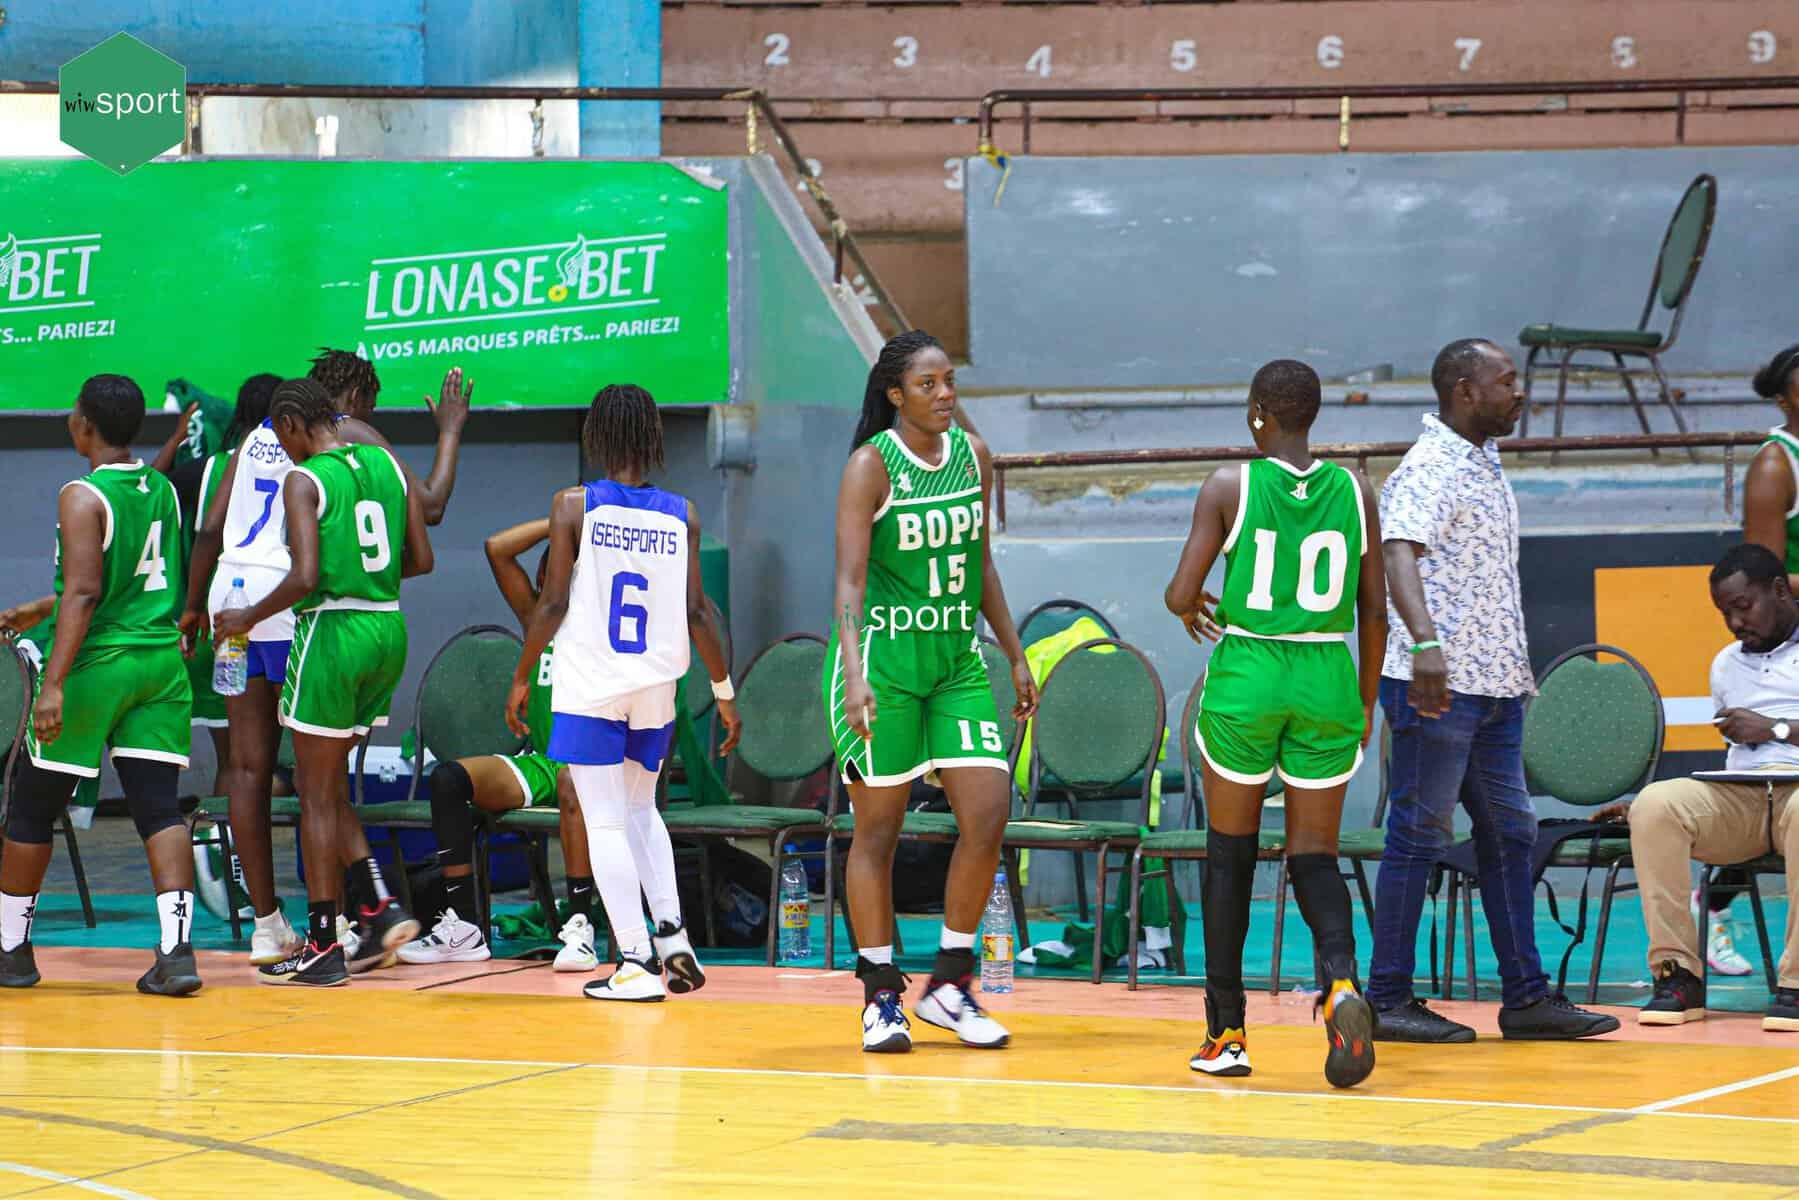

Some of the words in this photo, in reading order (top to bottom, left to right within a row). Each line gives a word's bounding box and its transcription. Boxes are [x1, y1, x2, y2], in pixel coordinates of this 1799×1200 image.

[764, 32, 791, 65] 2
[894, 36, 918, 67] 3
[1025, 44, 1052, 78] 4
[1171, 40, 1196, 72] 5
[1317, 35, 1344, 69] 6
[1454, 36, 1482, 72] 7
[1748, 31, 1776, 63] 9
[943, 158, 965, 190] 3
[8, 245, 101, 302] BET
[365, 254, 549, 320] LONASE
[578, 244, 666, 300] BET
[0, 327, 33, 344] S...
[38, 319, 116, 342] PARIEZ!
[372, 340, 413, 360] VOS
[417, 331, 518, 356] MARQUES
[522, 324, 601, 347] PRÊTS...
[604, 316, 680, 339] PARIEZ!
[234, 477, 280, 548] 7
[896, 501, 984, 551] BOPP
[134, 520, 168, 592] 4
[354, 500, 392, 573] 9
[928, 552, 968, 598] 15
[1246, 528, 1348, 612] 10
[608, 571, 649, 655] 6
[958, 719, 1002, 752] 15
